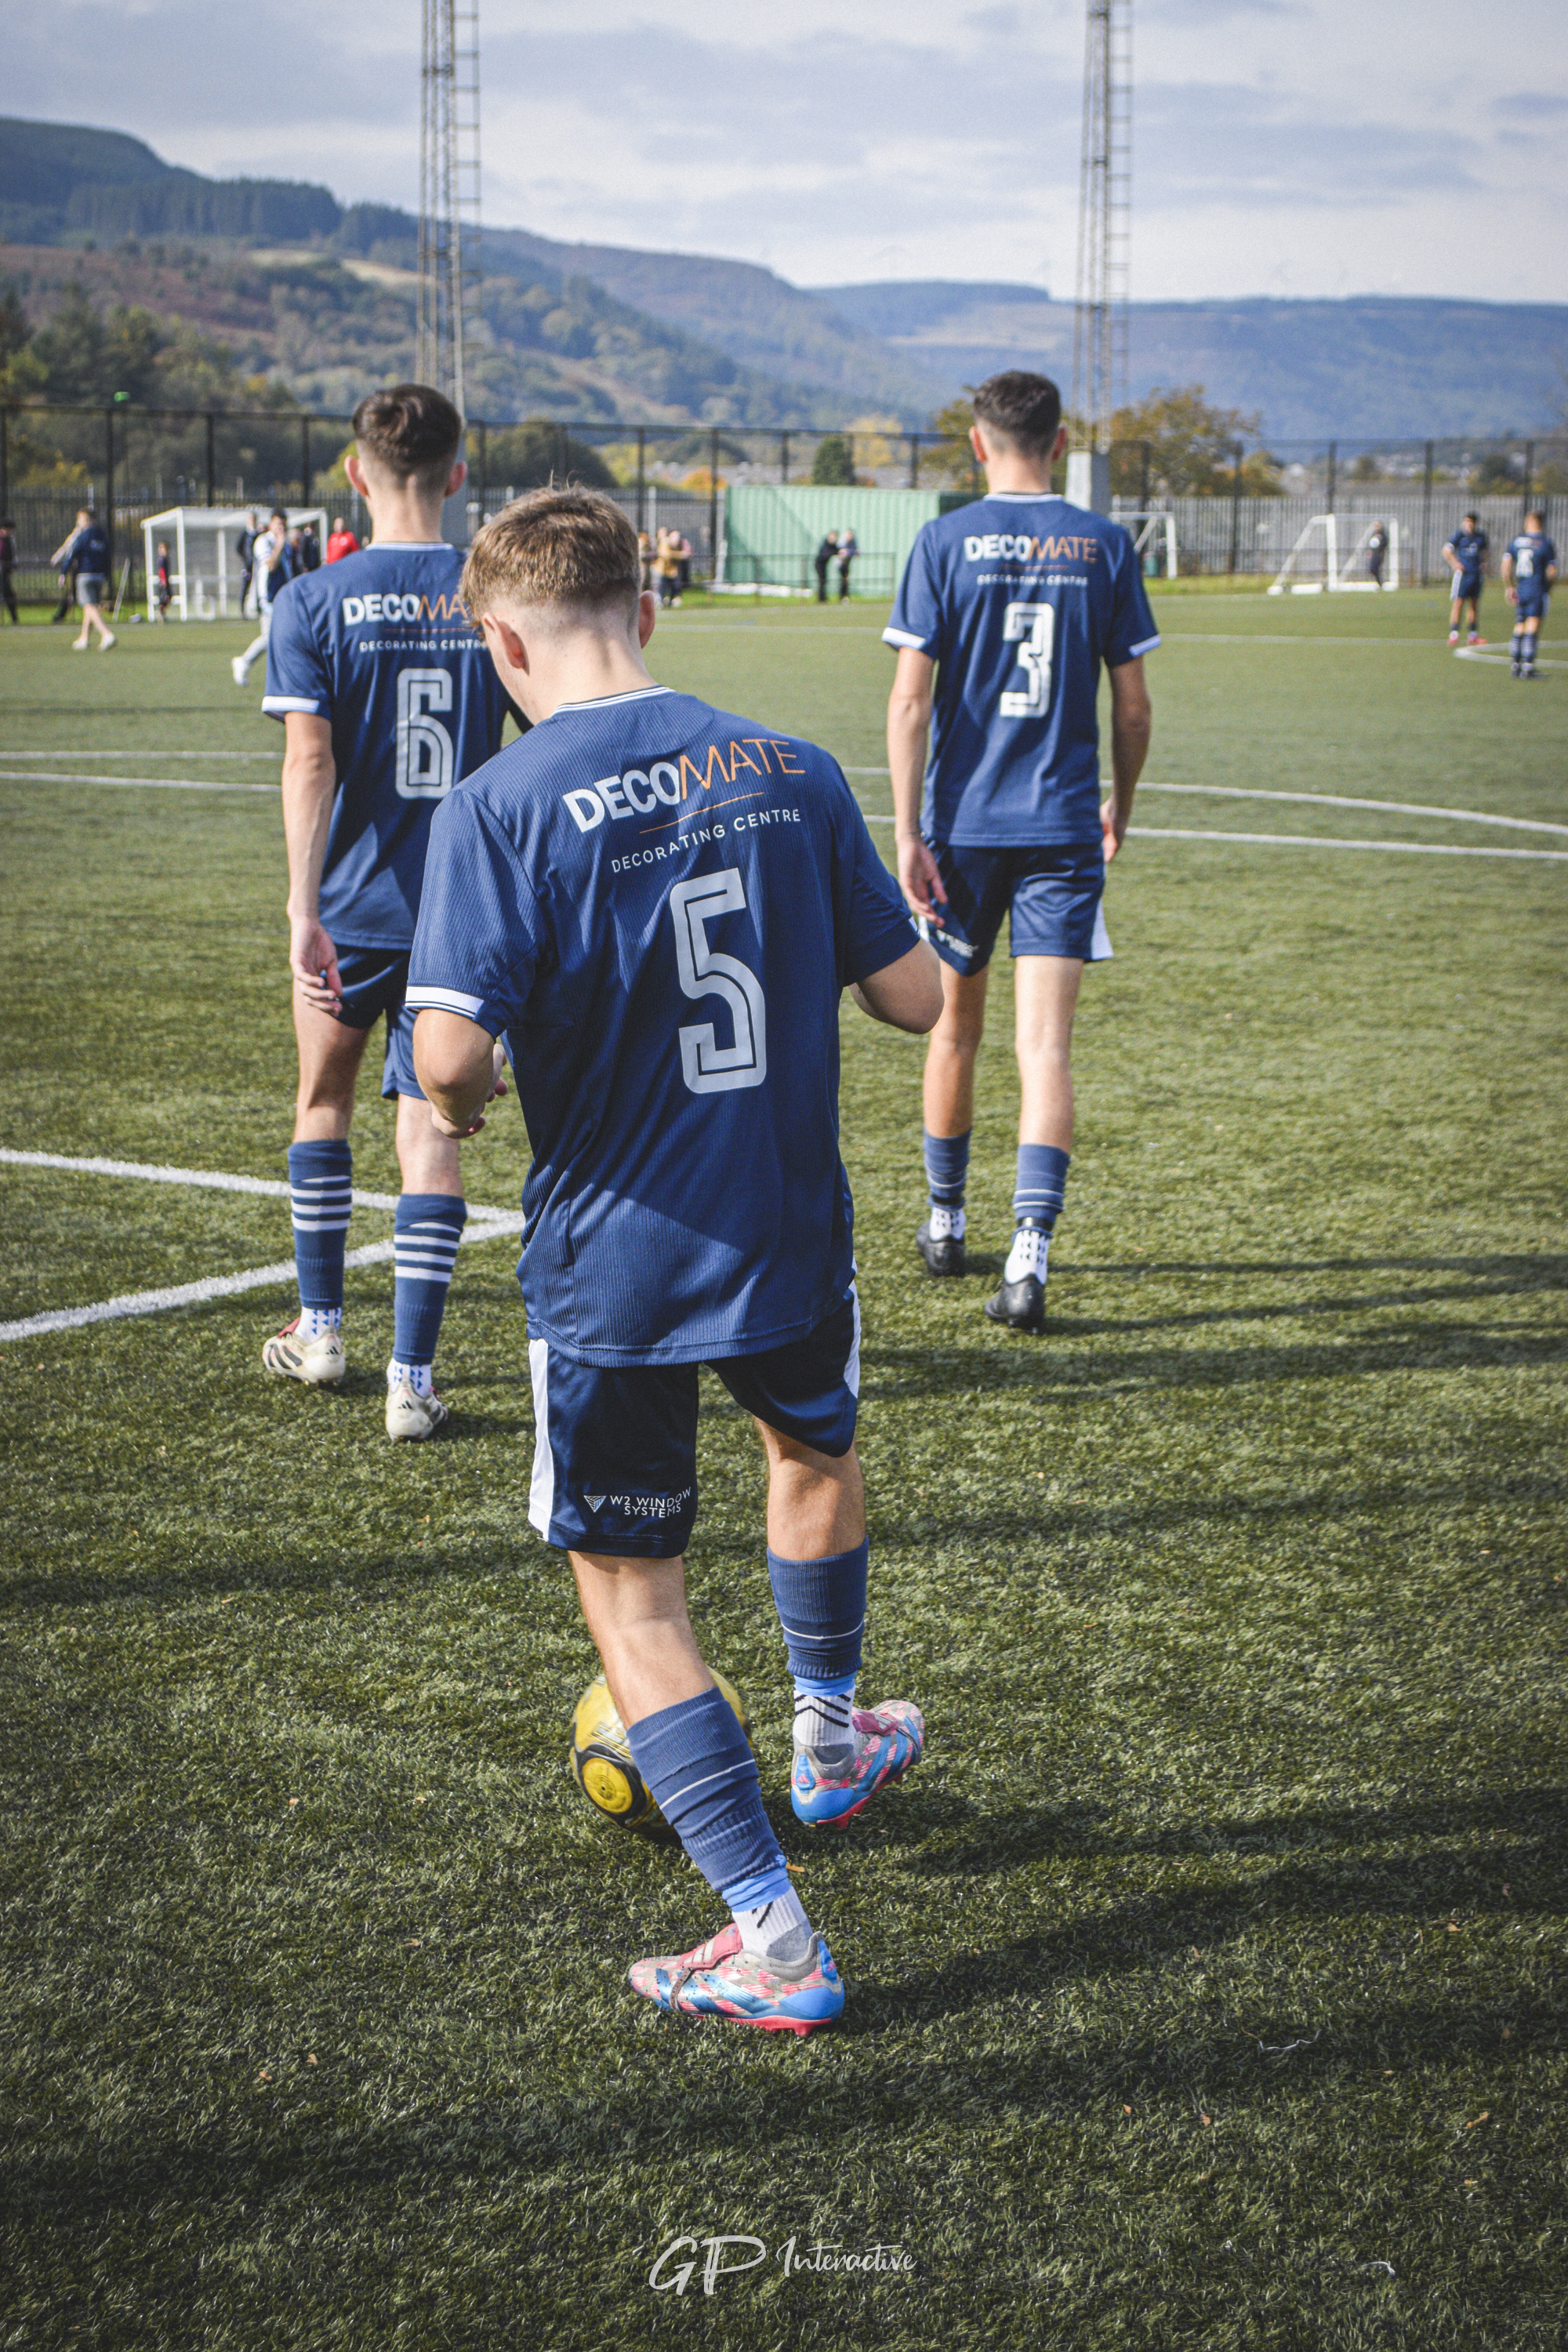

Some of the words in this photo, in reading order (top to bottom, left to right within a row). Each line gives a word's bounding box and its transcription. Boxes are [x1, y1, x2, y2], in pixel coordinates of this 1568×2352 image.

[964, 534, 1097, 562] DECOMATE
[1046, 575, 1088, 586] CENTRE
[342, 593, 468, 626] DECOMA
[359, 640, 437, 653] DECORATING
[441, 639, 488, 651] CENTR
[1000, 602, 1054, 717] 3
[395, 668, 454, 799] 6
[562, 739, 806, 833] DECOMATE
[612, 823, 726, 873] DECORATING
[734, 808, 800, 832] CENTRE
[670, 867, 767, 1094] 5
[610, 1495, 630, 1504] W2
[636, 1486, 691, 1507] WINDOW
[624, 1502, 681, 1518] SYSTEMS
